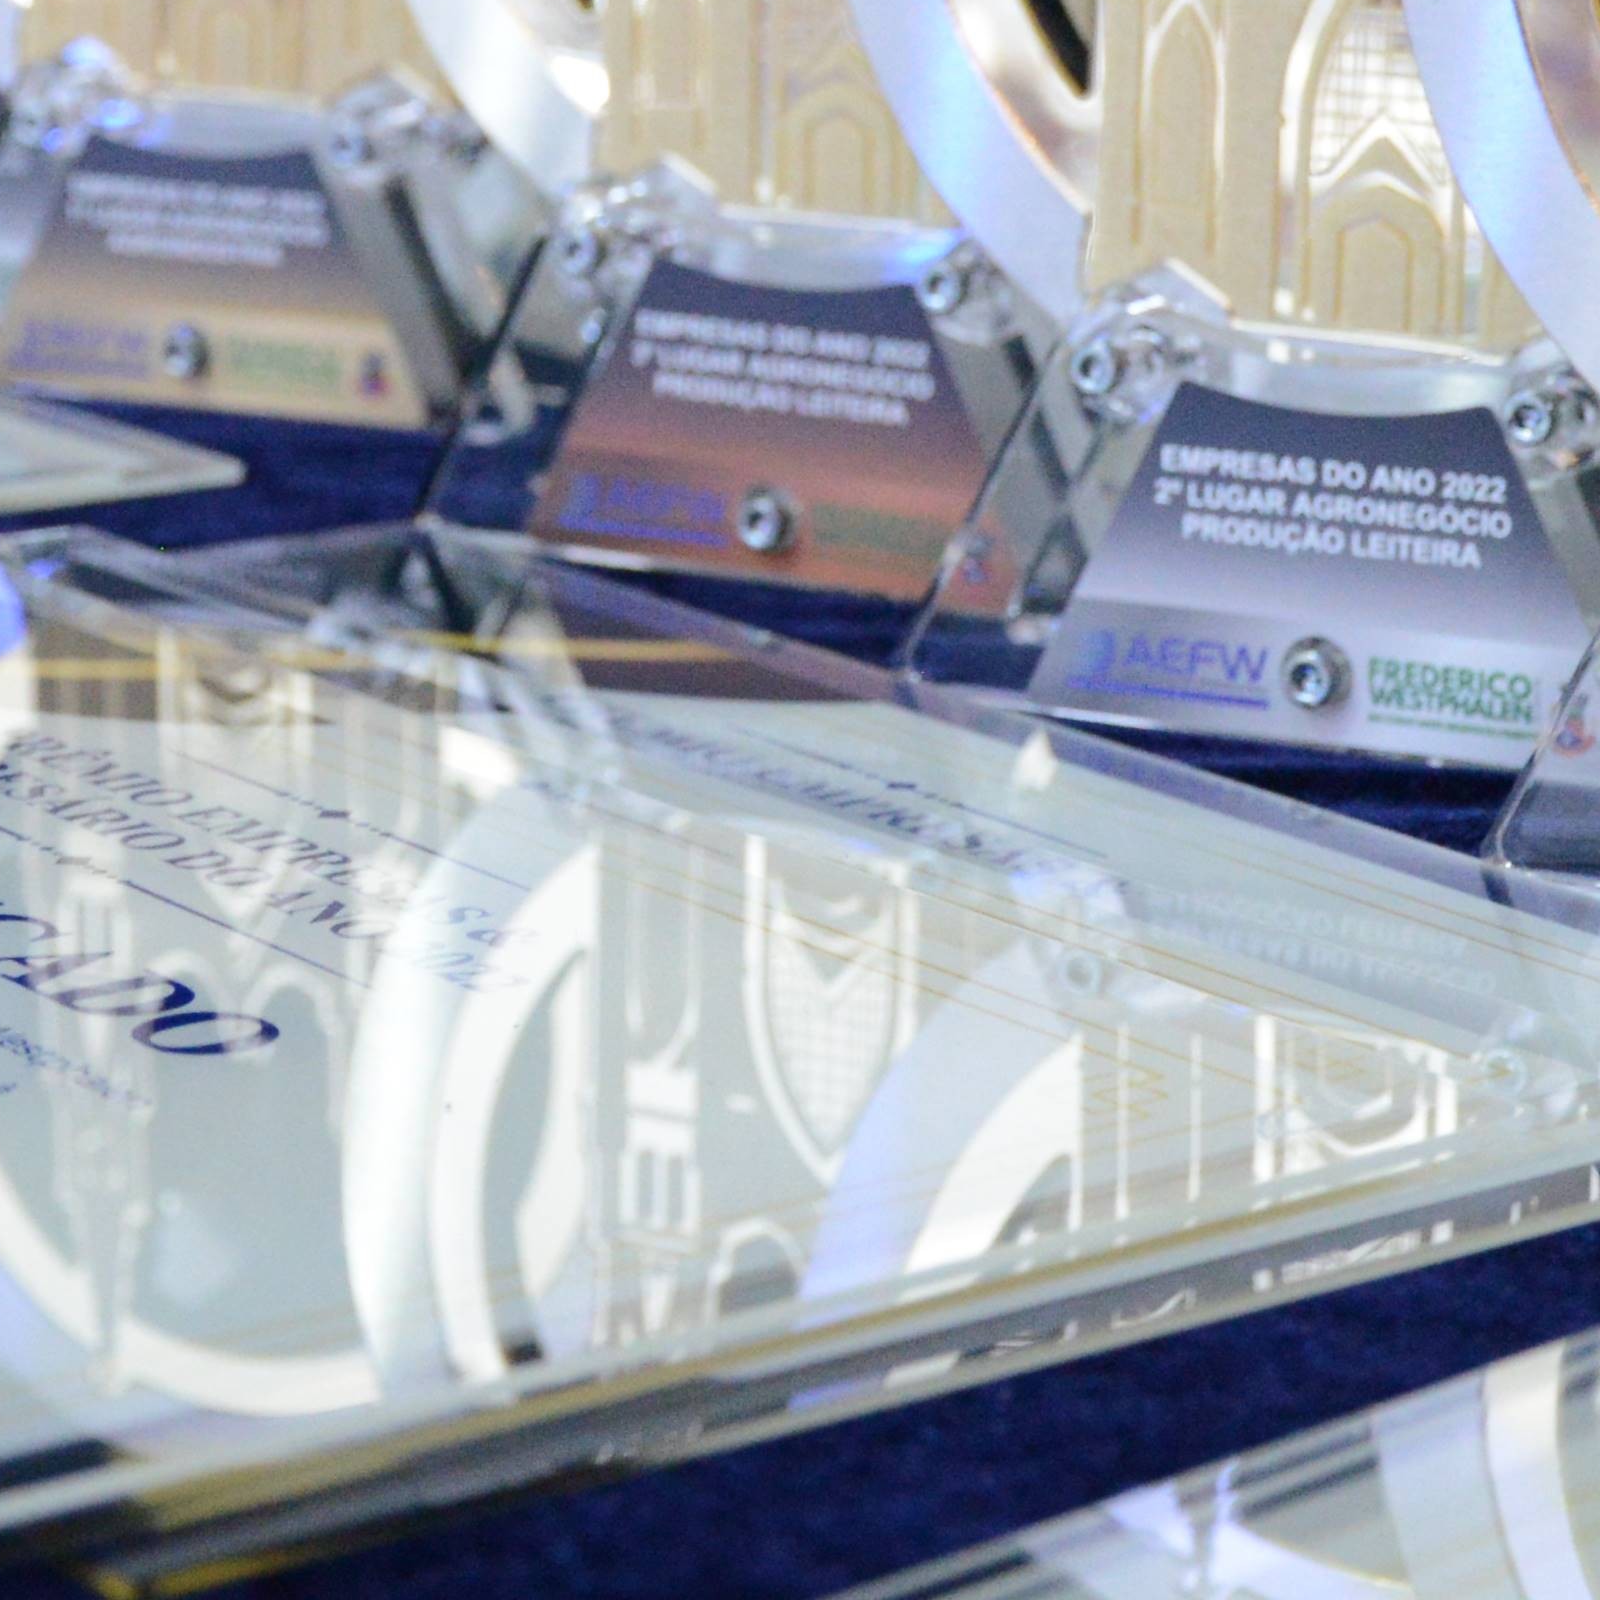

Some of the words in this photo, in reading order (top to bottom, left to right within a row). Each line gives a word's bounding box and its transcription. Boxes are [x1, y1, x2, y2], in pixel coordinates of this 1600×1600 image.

[1160, 443, 1317, 486] EMPRESAS
[1321, 459, 1366, 490] DO
[1370, 465, 1436, 496] ANO
[1441, 471, 1507, 504] 2022
[1187, 480, 1287, 515] LUGAR
[1290, 490, 1513, 539] AGRONEGÓCIO
[1181, 512, 1345, 556] PRODUÇÃO
[1351, 530, 1483, 569] LEITEIRA
[1122, 634, 1271, 683] AEFW
[1367, 657, 1533, 700] FREDERICO
[1367, 684, 1535, 724] WESTPHALEN
[165, 850, 269, 888] DO
